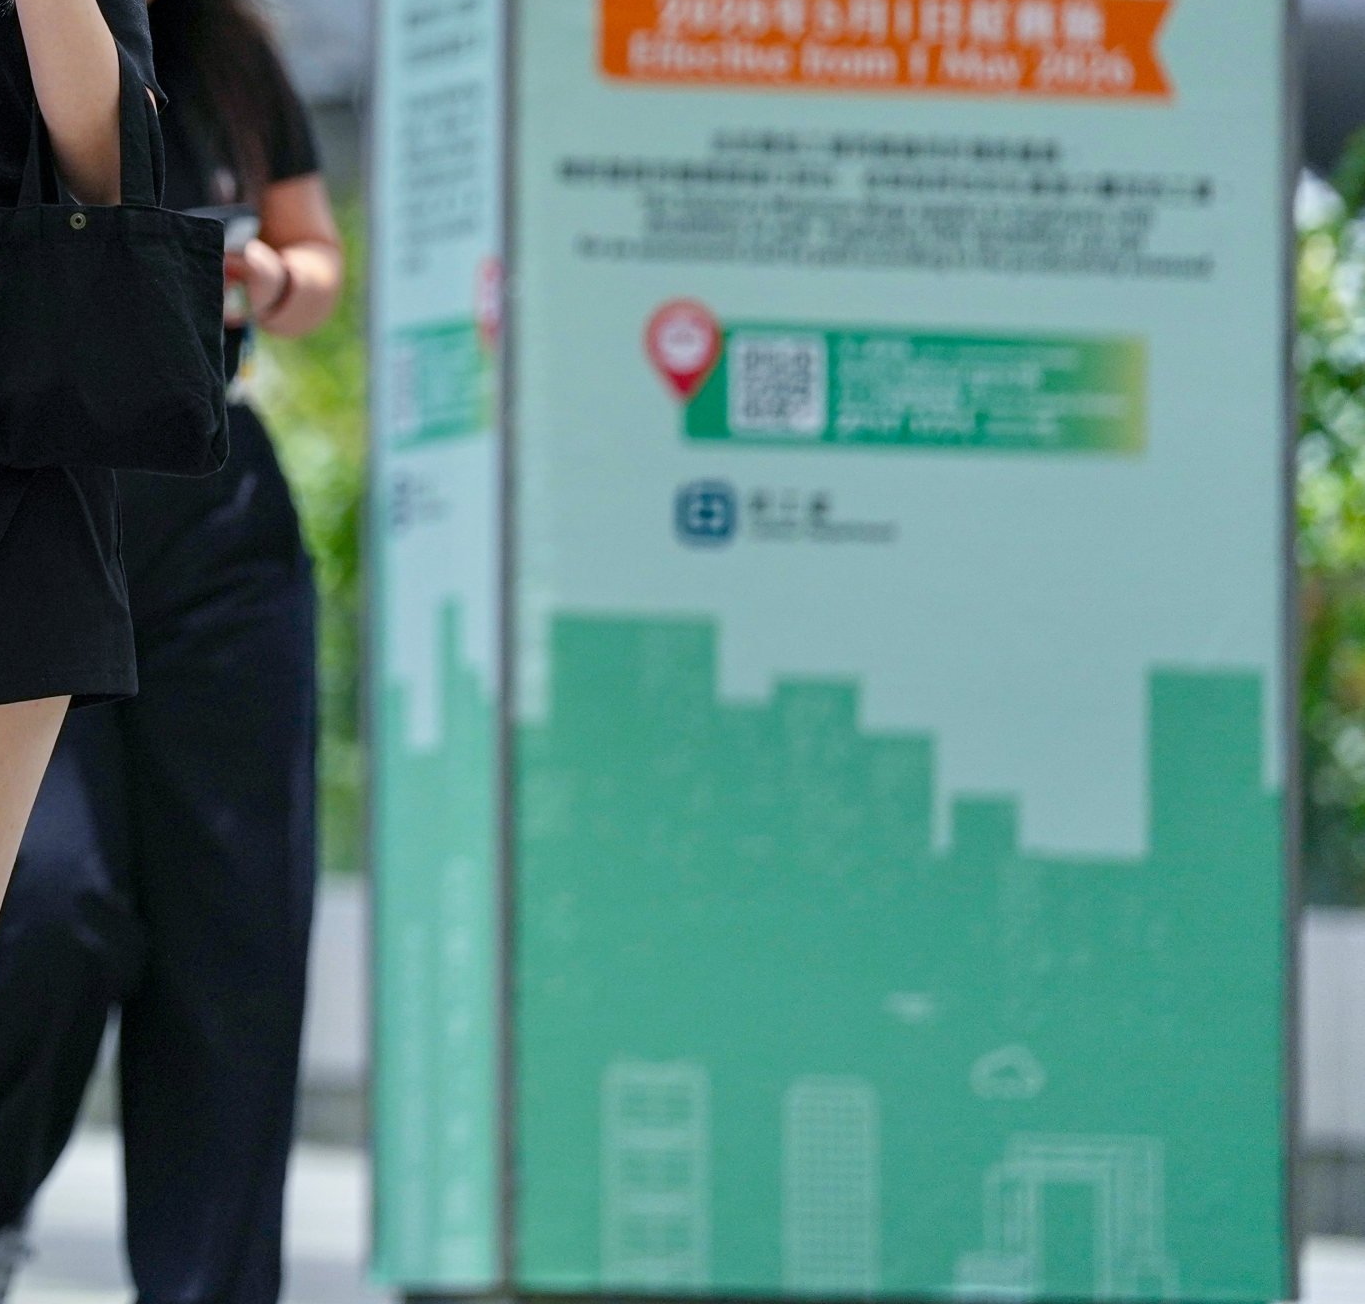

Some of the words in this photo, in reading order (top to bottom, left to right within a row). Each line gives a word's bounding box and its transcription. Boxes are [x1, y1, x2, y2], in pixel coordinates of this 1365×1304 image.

[627, 28, 795, 76] Effective
[800, 40, 900, 81] from
[940, 46, 1021, 88] May
